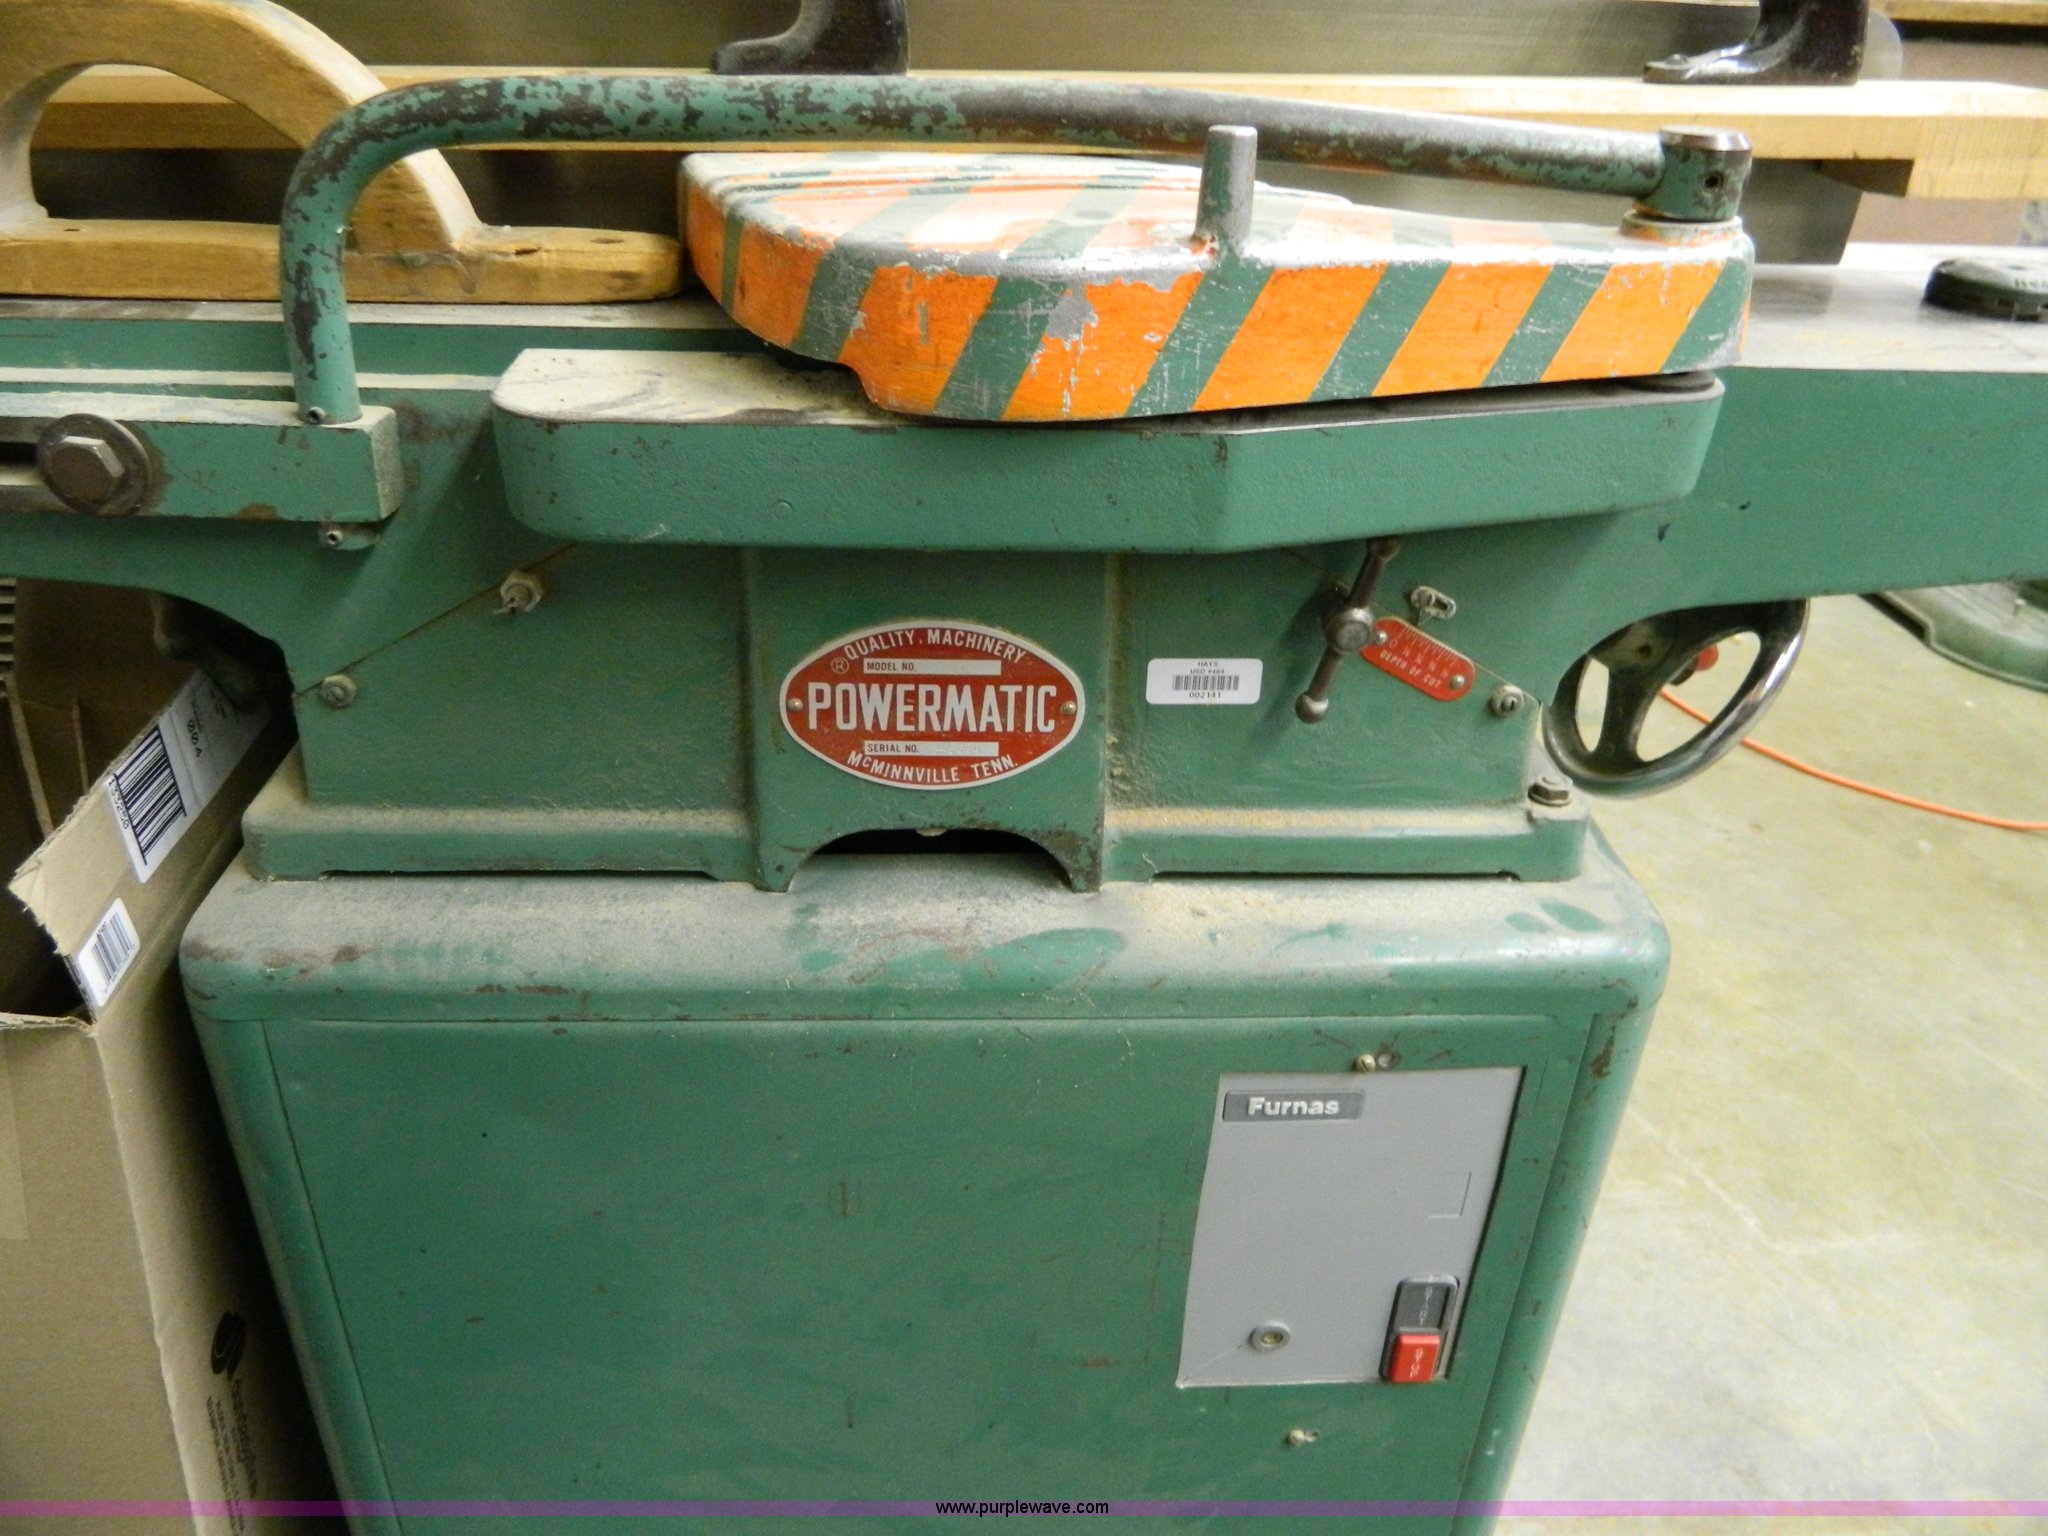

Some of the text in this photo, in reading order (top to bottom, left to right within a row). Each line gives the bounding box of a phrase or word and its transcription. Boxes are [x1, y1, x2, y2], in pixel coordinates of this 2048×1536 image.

[844, 629, 1026, 664] QUALITY MACHINERY
[866, 662, 897, 671] MODEL
[807, 681, 1058, 733] POWERMATIC
[867, 743, 919, 753] SERIAL NO.
[970, 754, 1018, 779] TENN.
[1247, 1096, 1340, 1116] Furnas
